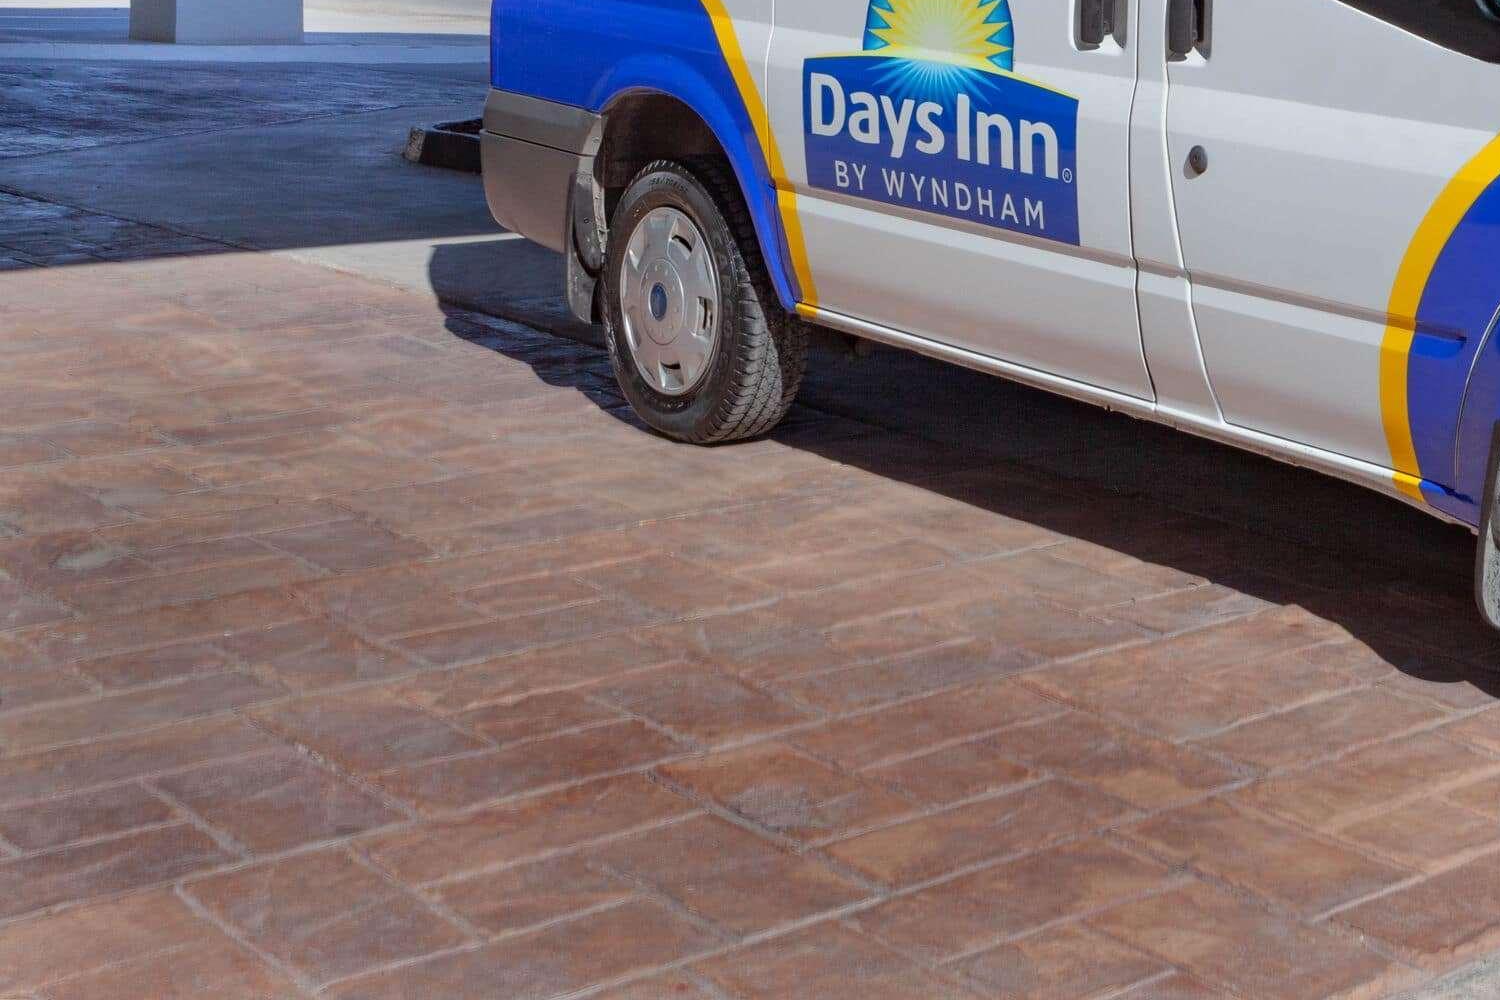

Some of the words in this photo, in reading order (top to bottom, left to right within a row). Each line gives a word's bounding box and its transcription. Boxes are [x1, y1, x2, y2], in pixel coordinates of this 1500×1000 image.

[810, 73, 944, 158] Days
[957, 93, 1059, 179] Inn
[835, 160, 867, 191] BY
[881, 167, 1045, 230] WYNDHAM
